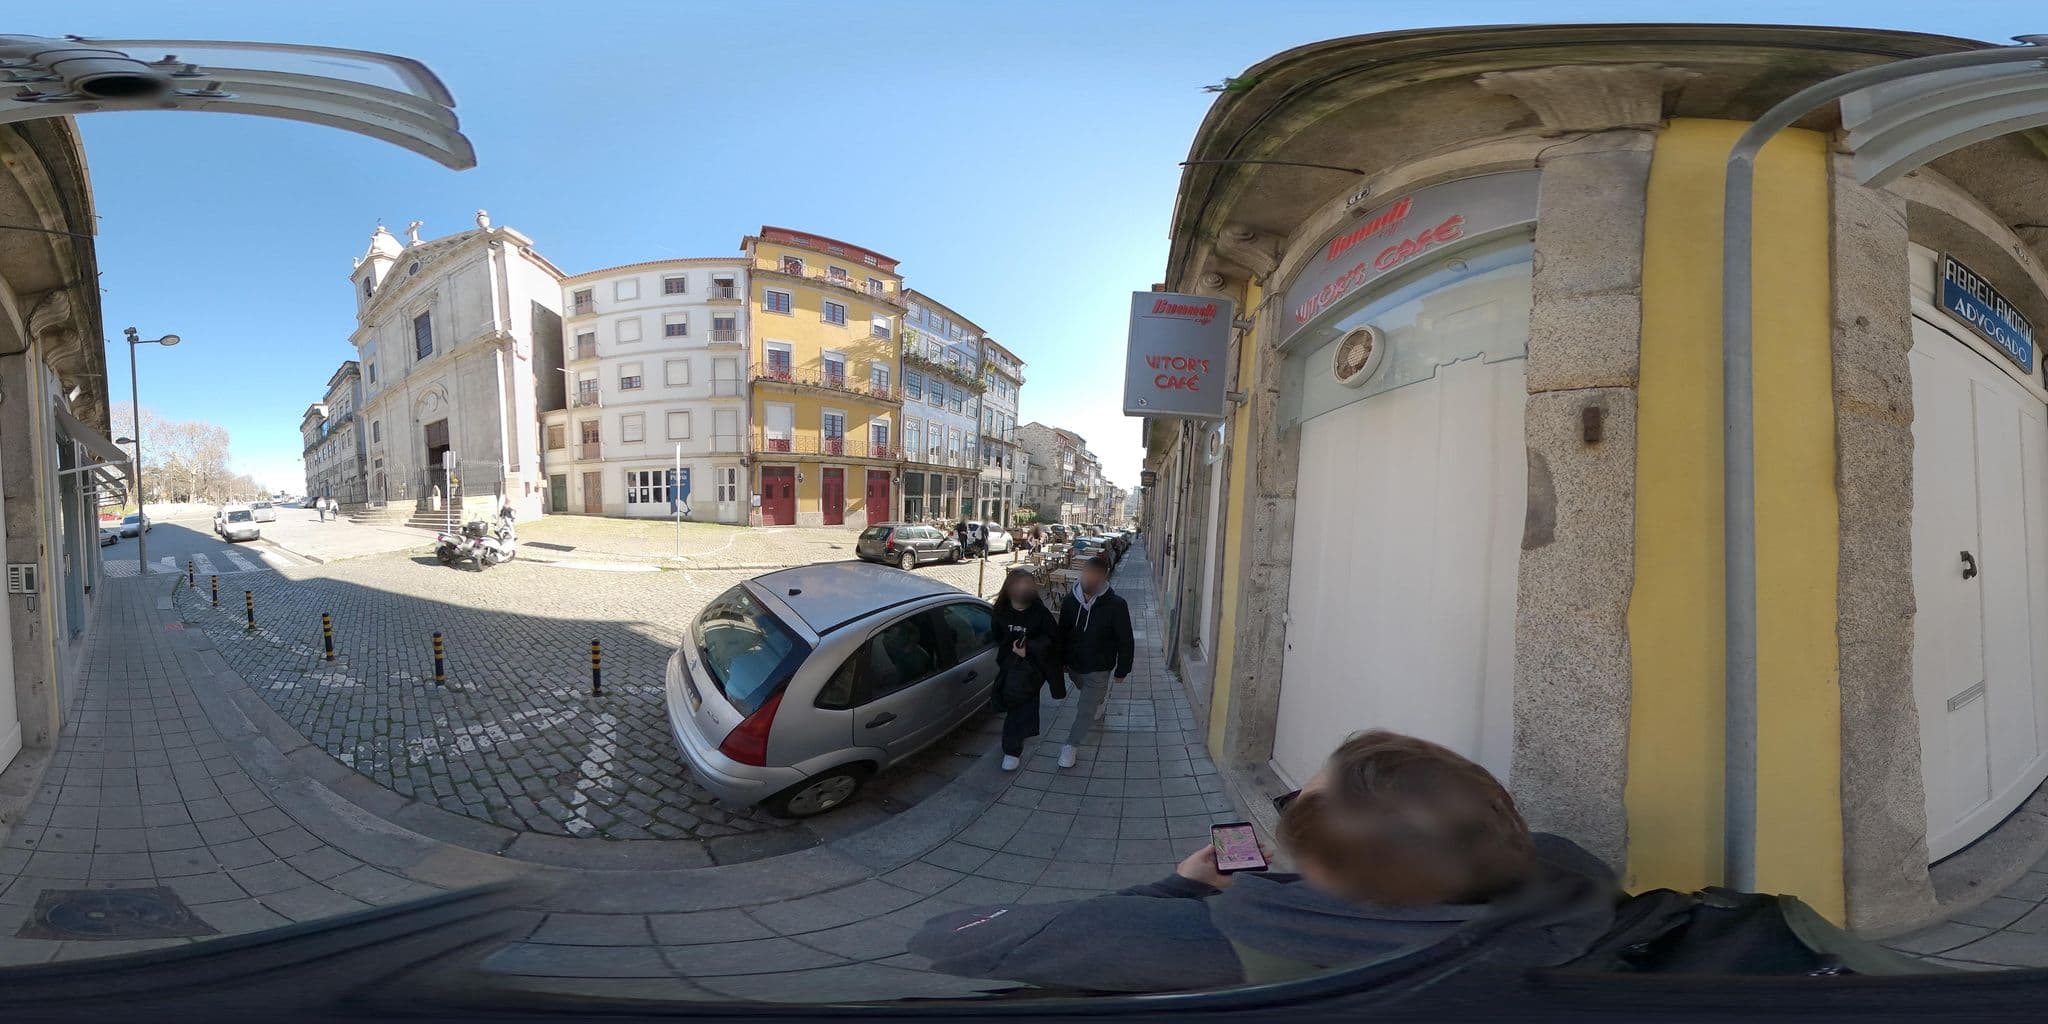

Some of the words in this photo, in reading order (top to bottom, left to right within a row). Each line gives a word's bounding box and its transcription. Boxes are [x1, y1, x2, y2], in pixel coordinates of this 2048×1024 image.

[1946, 259, 1994, 311] ABREU
[1996, 297, 2033, 347] AMORIM
[1954, 298, 2028, 363] ADVOGADO
[1145, 354, 1210, 374] VITOR'S
